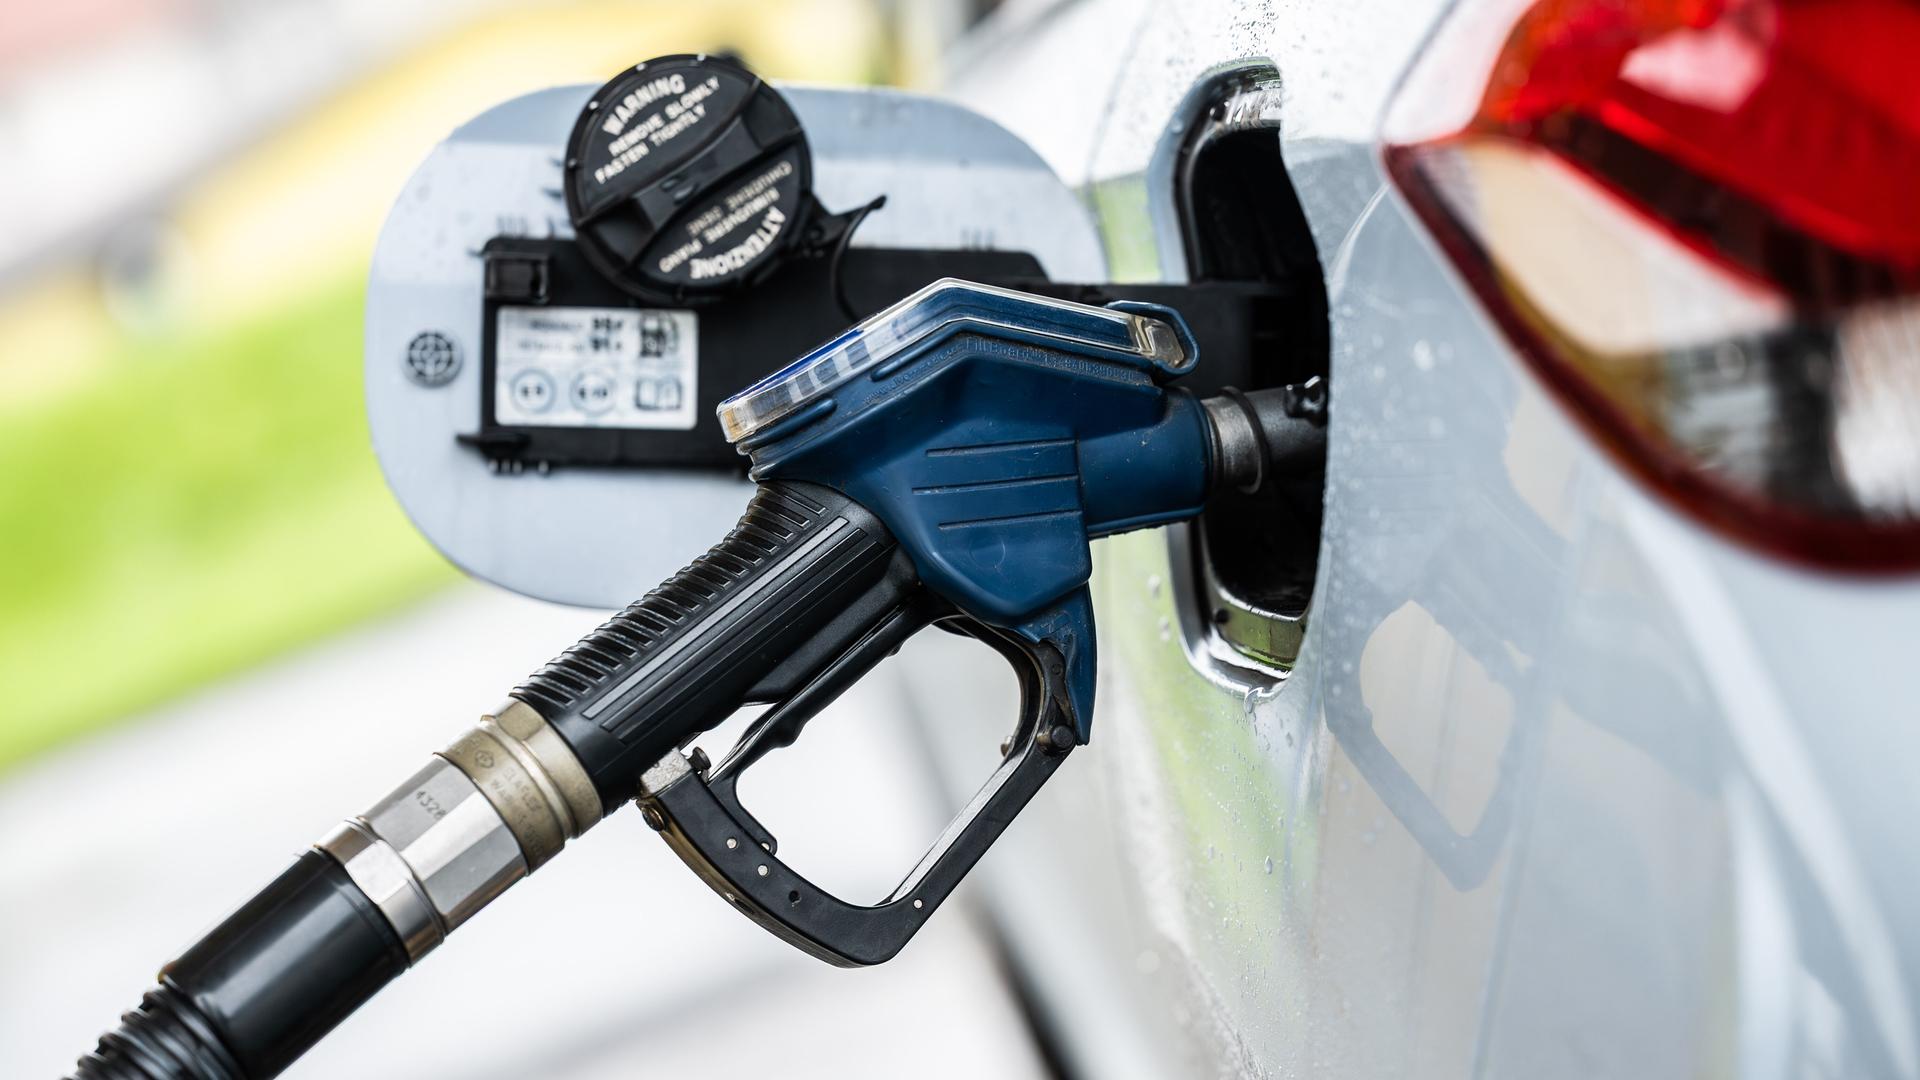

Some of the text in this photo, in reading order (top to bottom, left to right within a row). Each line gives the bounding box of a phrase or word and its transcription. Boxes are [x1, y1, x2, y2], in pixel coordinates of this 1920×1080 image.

[602, 73, 686, 135] WARNING
[608, 75, 720, 157] REMOVE SLOWLY
[594, 102, 706, 185] FASTEN TIGHTLY
[658, 238, 703, 274] PIANO
[689, 205, 787, 280] ATTENZIONE
